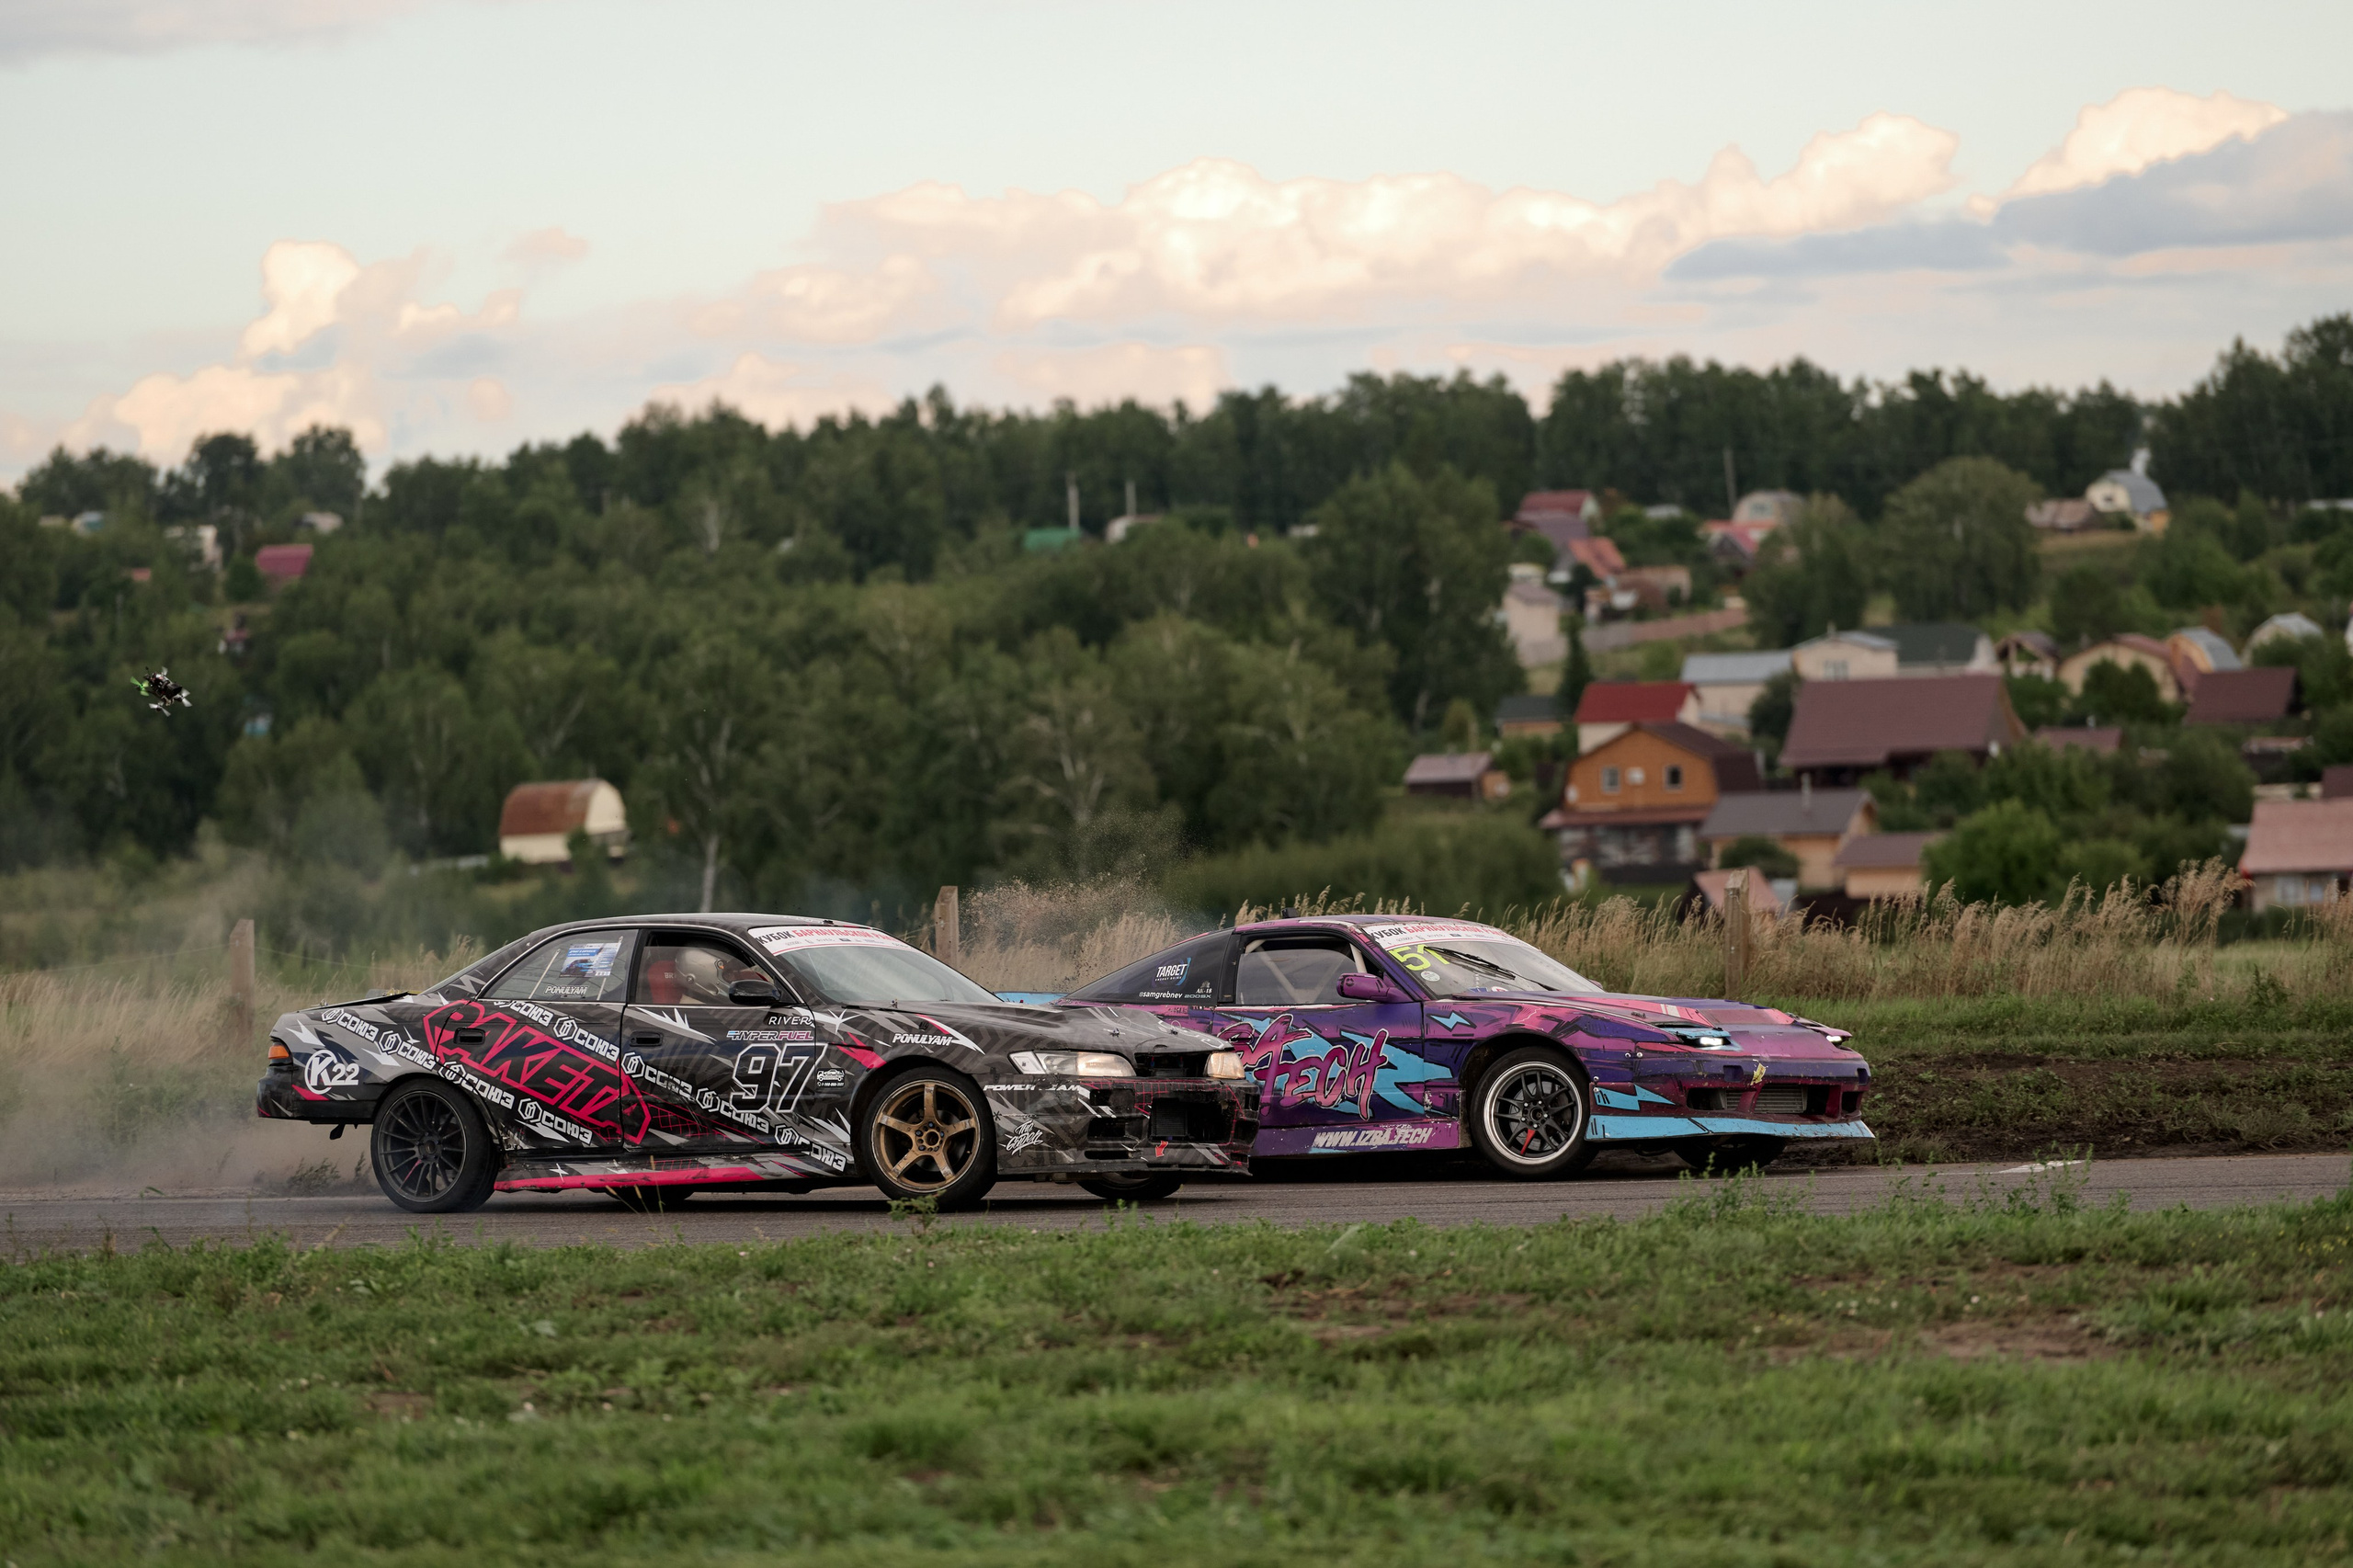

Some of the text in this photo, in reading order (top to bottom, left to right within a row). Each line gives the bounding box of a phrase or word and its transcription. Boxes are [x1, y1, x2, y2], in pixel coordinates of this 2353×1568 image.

[756, 930, 795, 944] КУБОК
[1370, 927, 1406, 939] КУБОК
[1156, 964, 1188, 977] TARGET
[1389, 944, 1449, 971] 51
[545, 985, 588, 994] PONULYAM
[337, 1013, 379, 1041] СОЮЗ
[510, 1001, 553, 1027] СОЮЗ
[768, 1016, 811, 1025] RIVER
[574, 1028, 620, 1062] СОЮЗ
[892, 1033, 952, 1046] PONULYAM
[397, 1041, 439, 1070] СОЮЗ
[730, 1043, 828, 1113] 97
[460, 1074, 515, 1109] СОЮЗ
[541, 1110, 593, 1144] СОЮЗ
[1313, 1127, 1434, 1148] WWW.IZBA.TECH
